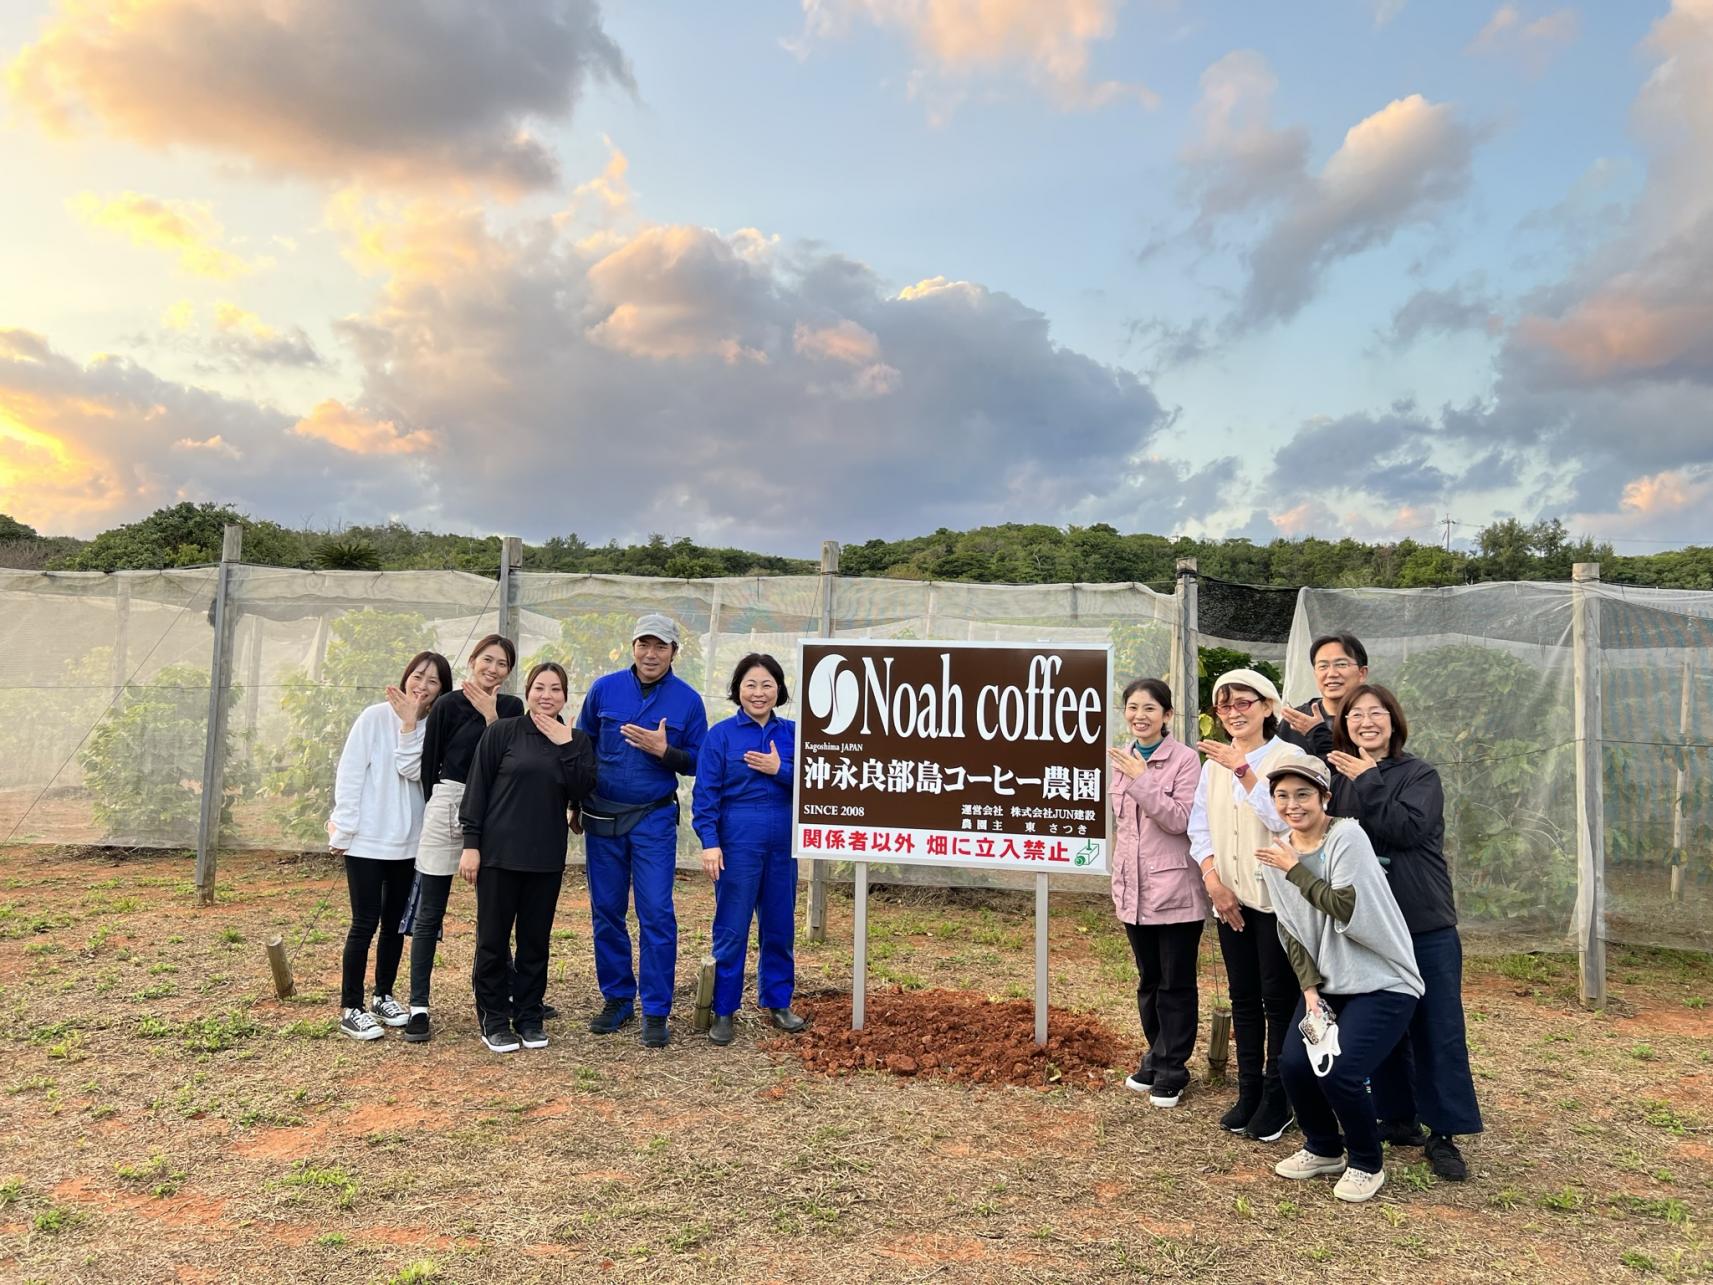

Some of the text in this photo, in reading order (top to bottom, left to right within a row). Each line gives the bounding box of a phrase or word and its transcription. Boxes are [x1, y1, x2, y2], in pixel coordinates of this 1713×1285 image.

[860, 653, 1101, 744] Noah coffee
[804, 742, 863, 753] Kagoshima JAPAN
[804, 756, 1101, 802] 沖永良部島コーヒー農園
[803, 805, 865, 816] SINCE 2008
[961, 804, 1096, 821] 運営会社 株式会社JUN建設
[803, 829, 1070, 863] 関係者以外 畑に立入禁止
